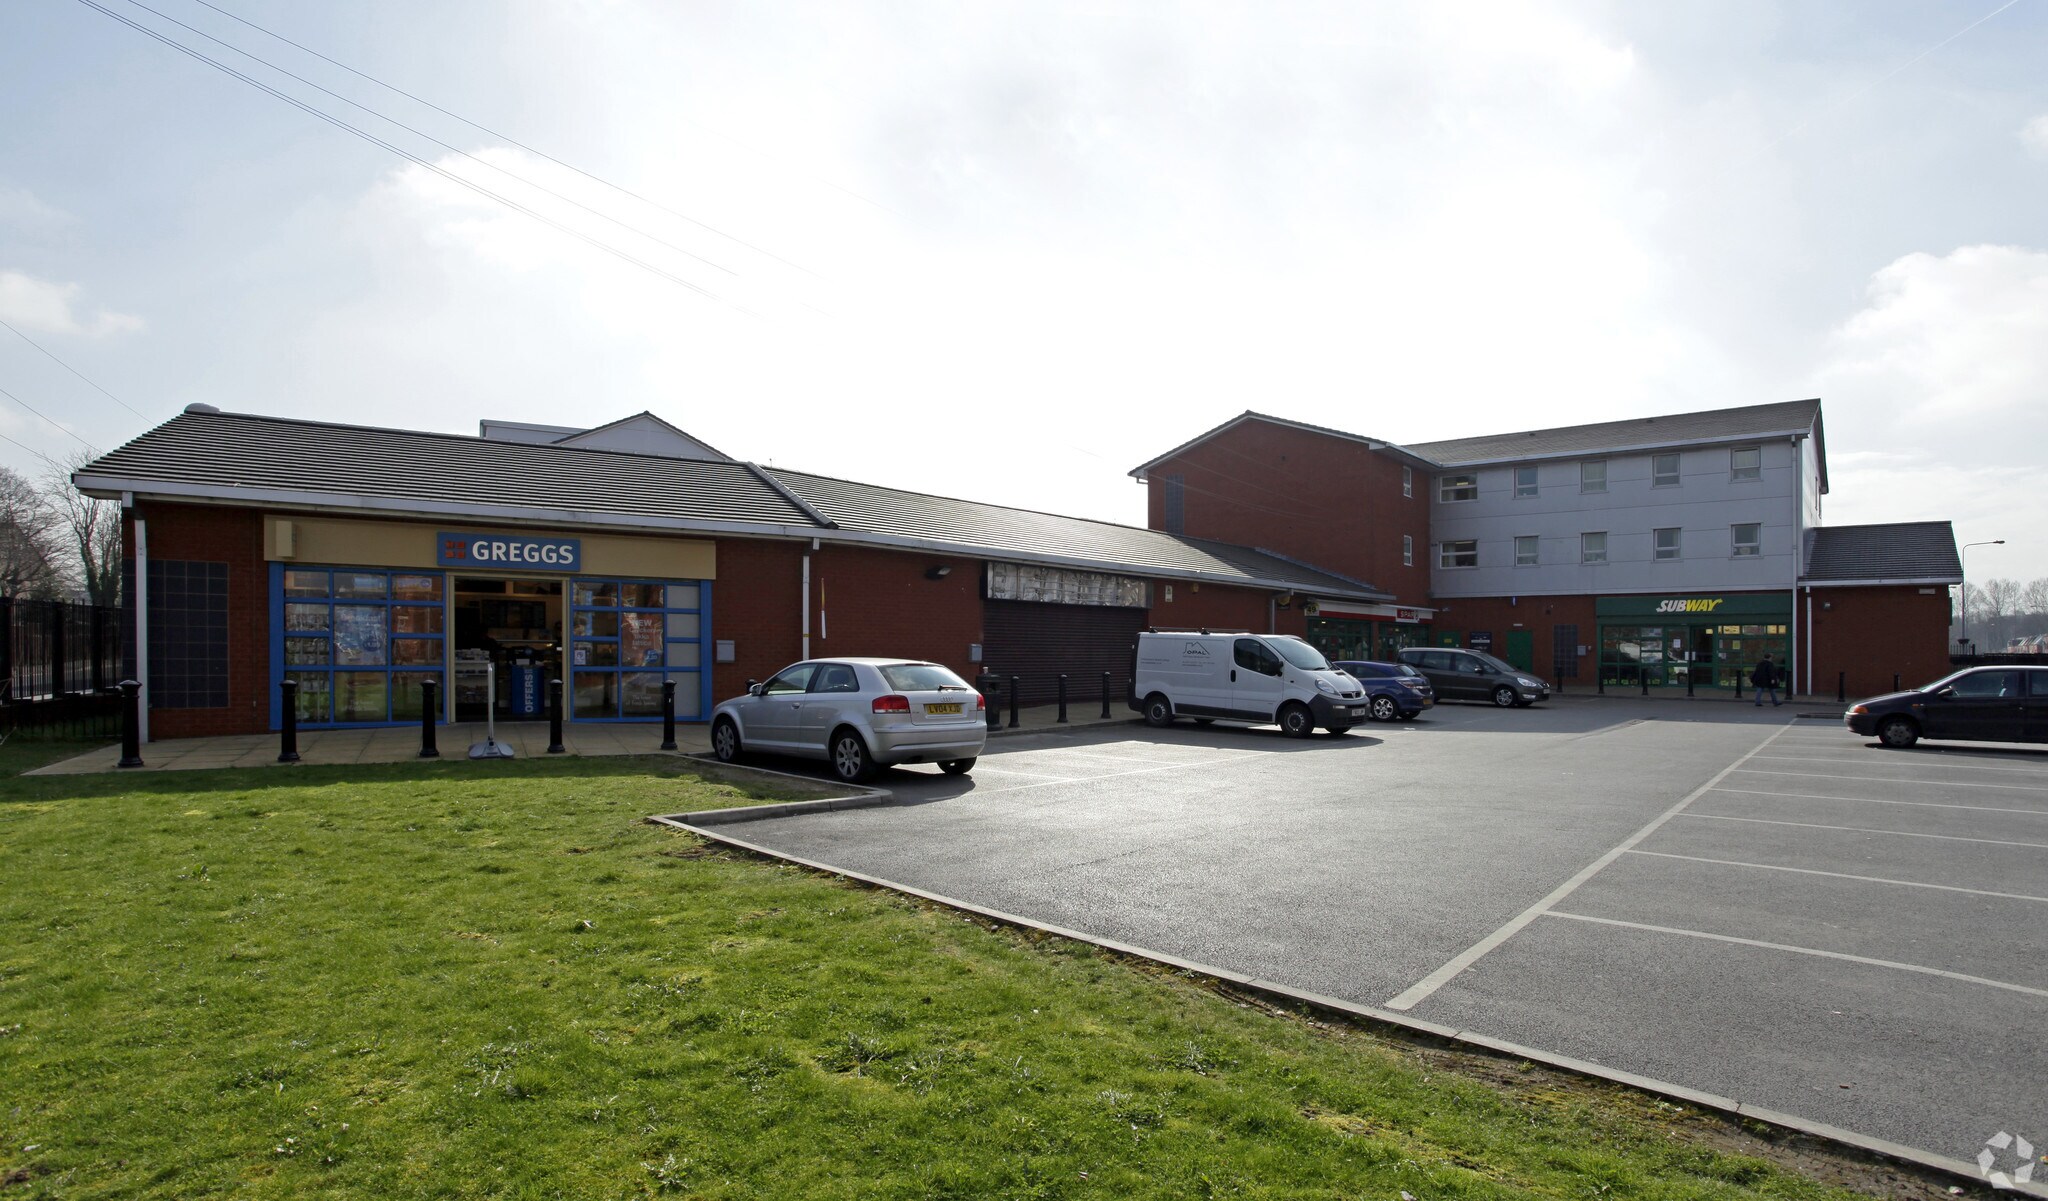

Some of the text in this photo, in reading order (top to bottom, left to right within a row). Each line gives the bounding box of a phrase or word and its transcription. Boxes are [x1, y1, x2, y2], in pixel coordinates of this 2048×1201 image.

[472, 541, 573, 564] GREGGS
[1656, 598, 1723, 612] SUBWAY
[525, 674, 534, 713] OFFERS
